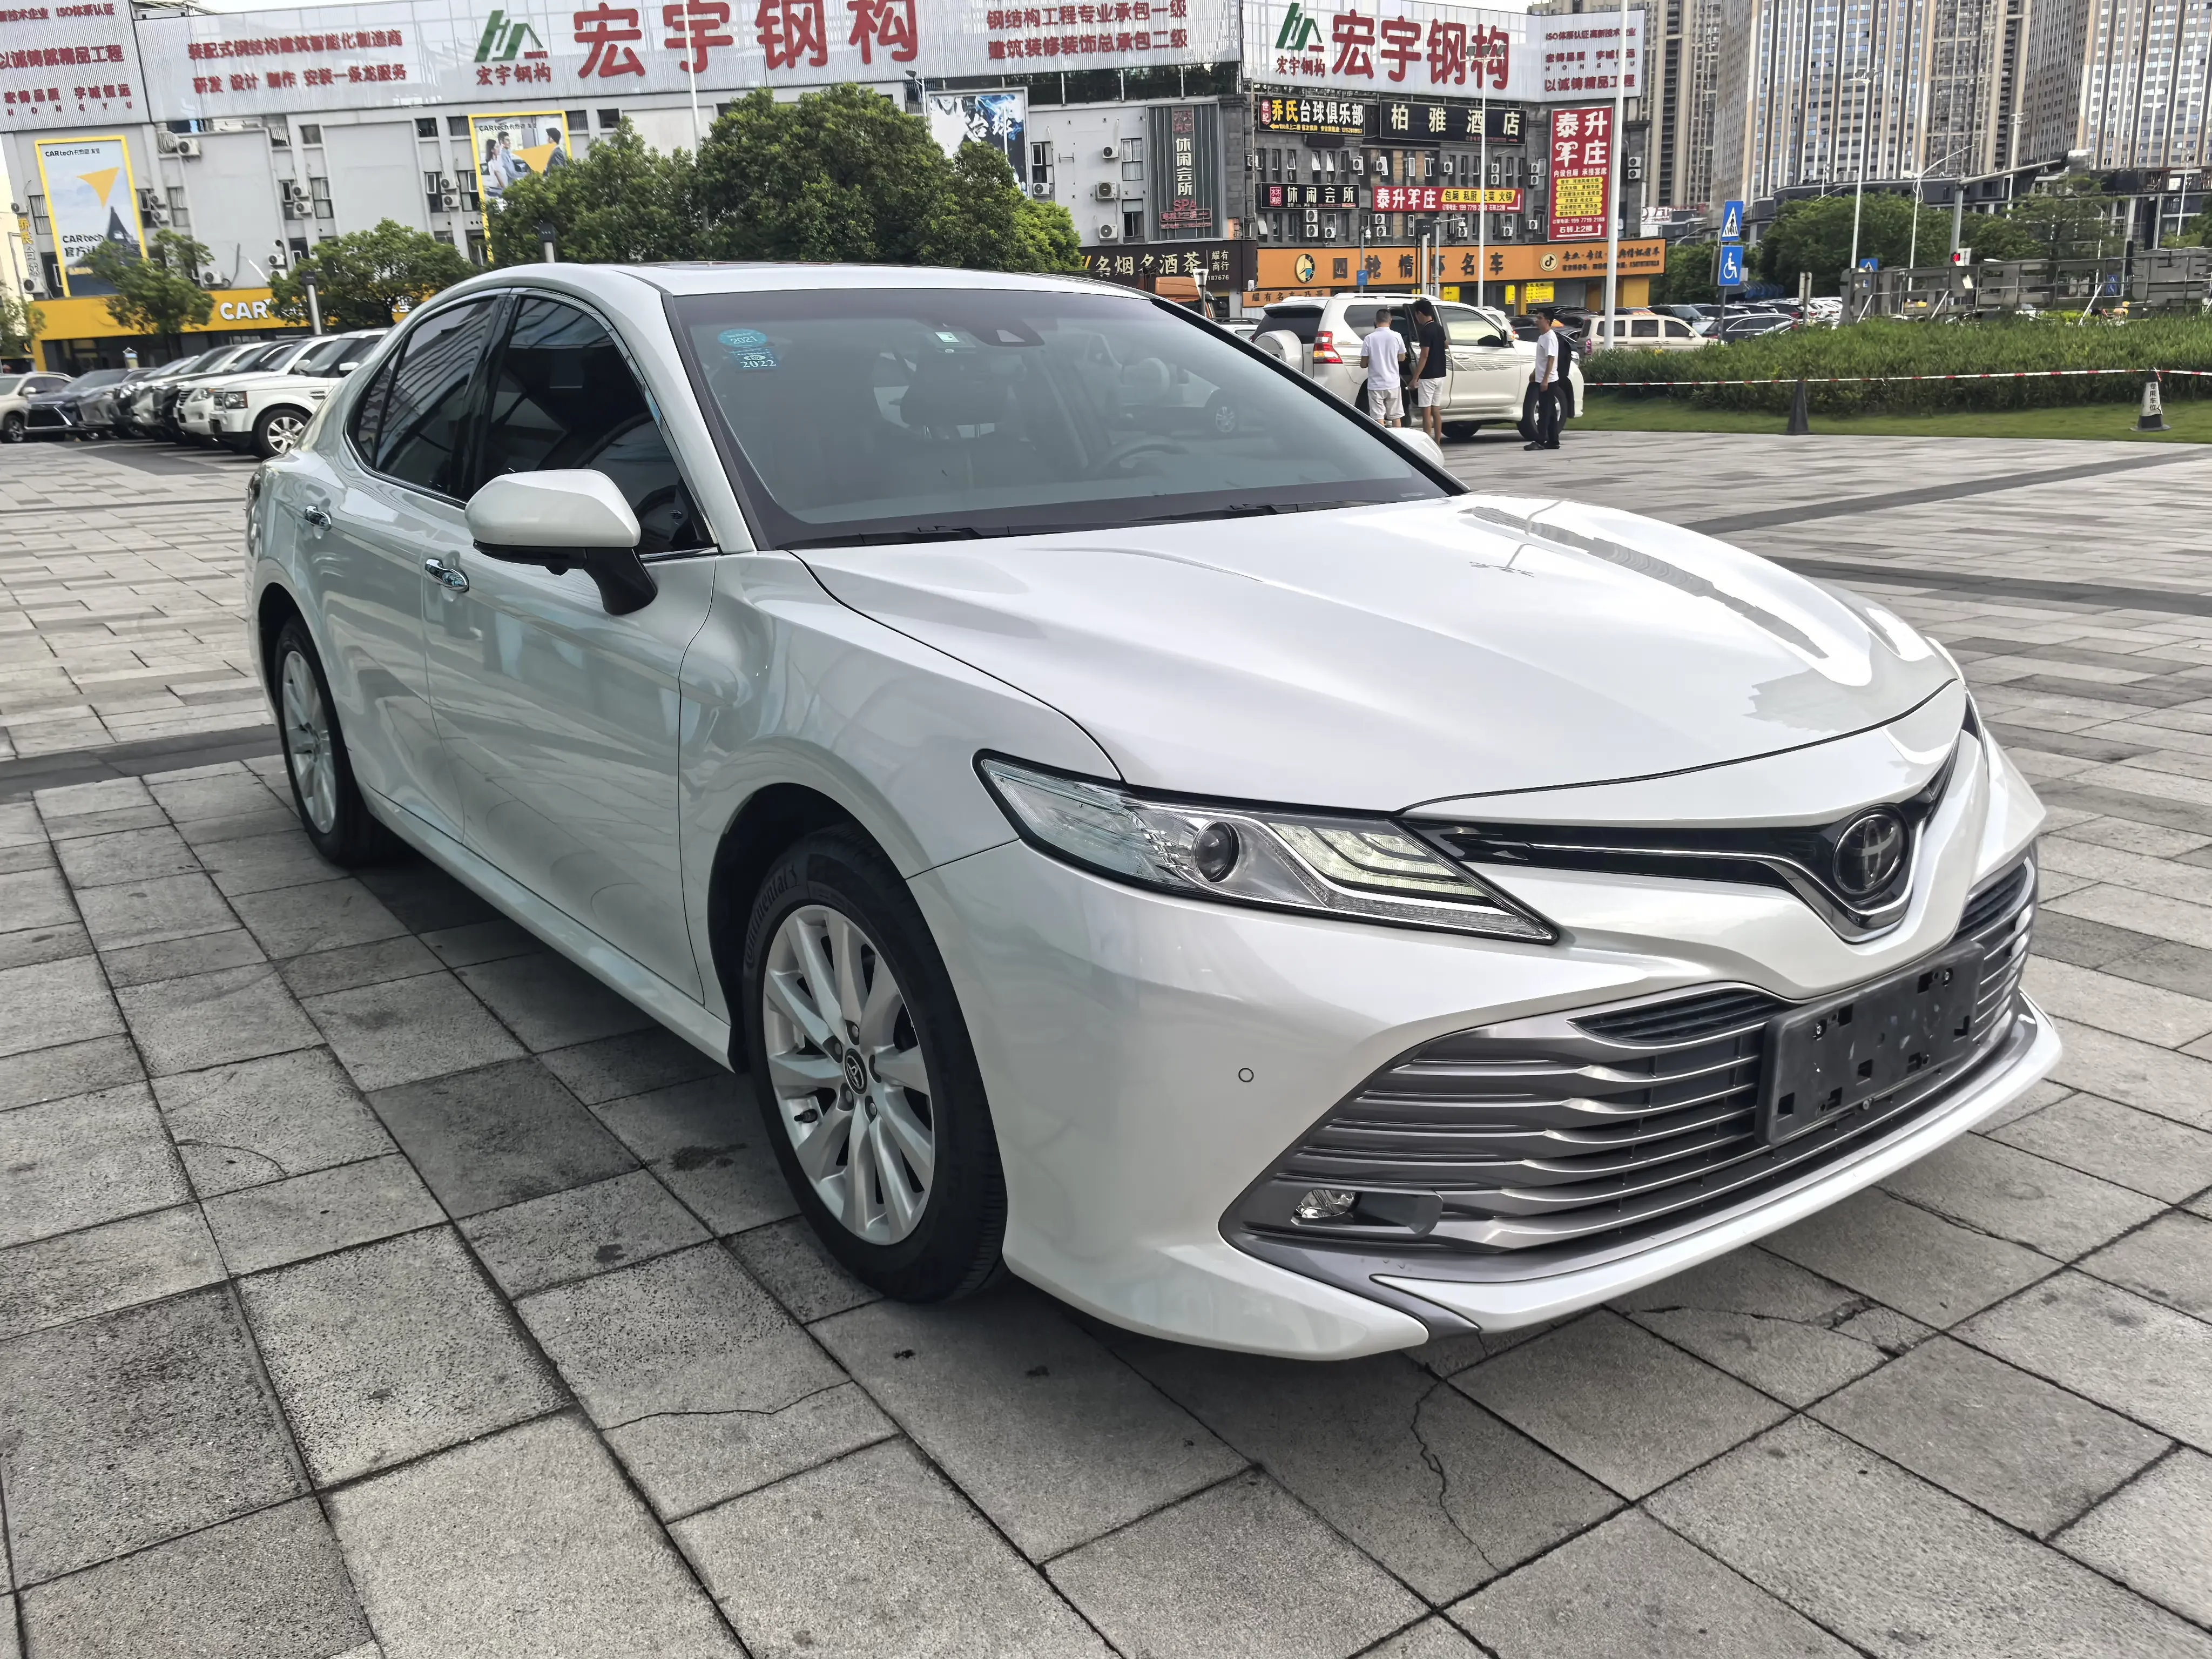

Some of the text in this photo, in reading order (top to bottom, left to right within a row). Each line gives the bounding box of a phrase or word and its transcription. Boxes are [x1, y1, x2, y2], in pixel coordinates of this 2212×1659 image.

[986, 0, 1187, 30] 钢结构工程专业承包一级
[574, 0, 919, 79] 宏宇钢构
[988, 29, 1188, 60] 建筑装修装饰总承包二级
[1331, 9, 1510, 90] 宏宇钢构
[476, 62, 552, 86] 宏宇钢构
[1275, 55, 1326, 78] 宏宇钢构
[230, 72, 260, 91] 设计
[1272, 99, 1364, 126] 乔氏台球俱乐部
[1391, 103, 1520, 136] 柏雅酒店
[1556, 111, 1608, 138] 泰升
[1176, 138, 1193, 196] 休闲会所
[1287, 186, 1354, 203] 休闲会所
[740, 360, 777, 368] 2022
